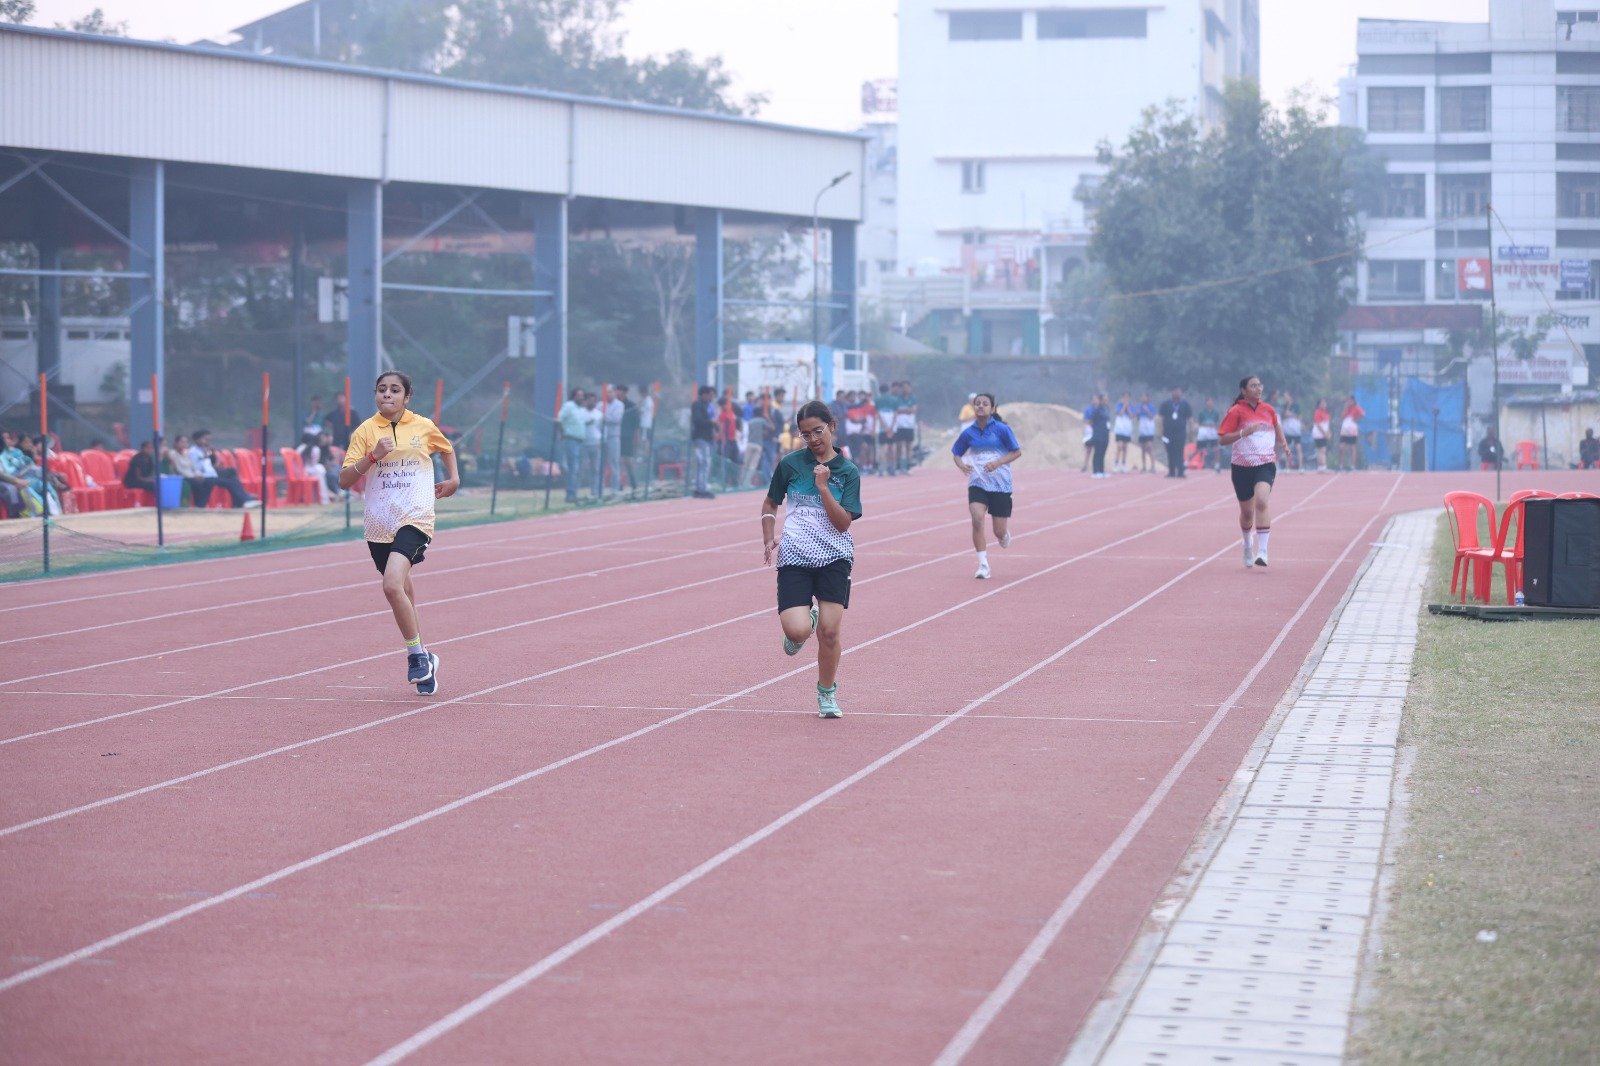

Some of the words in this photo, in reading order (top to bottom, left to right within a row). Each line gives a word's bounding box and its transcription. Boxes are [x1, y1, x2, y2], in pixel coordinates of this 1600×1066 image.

[376, 460, 399, 468] Mount
[401, 459, 420, 467] Litera
[381, 481, 411, 490] Jabalpur
